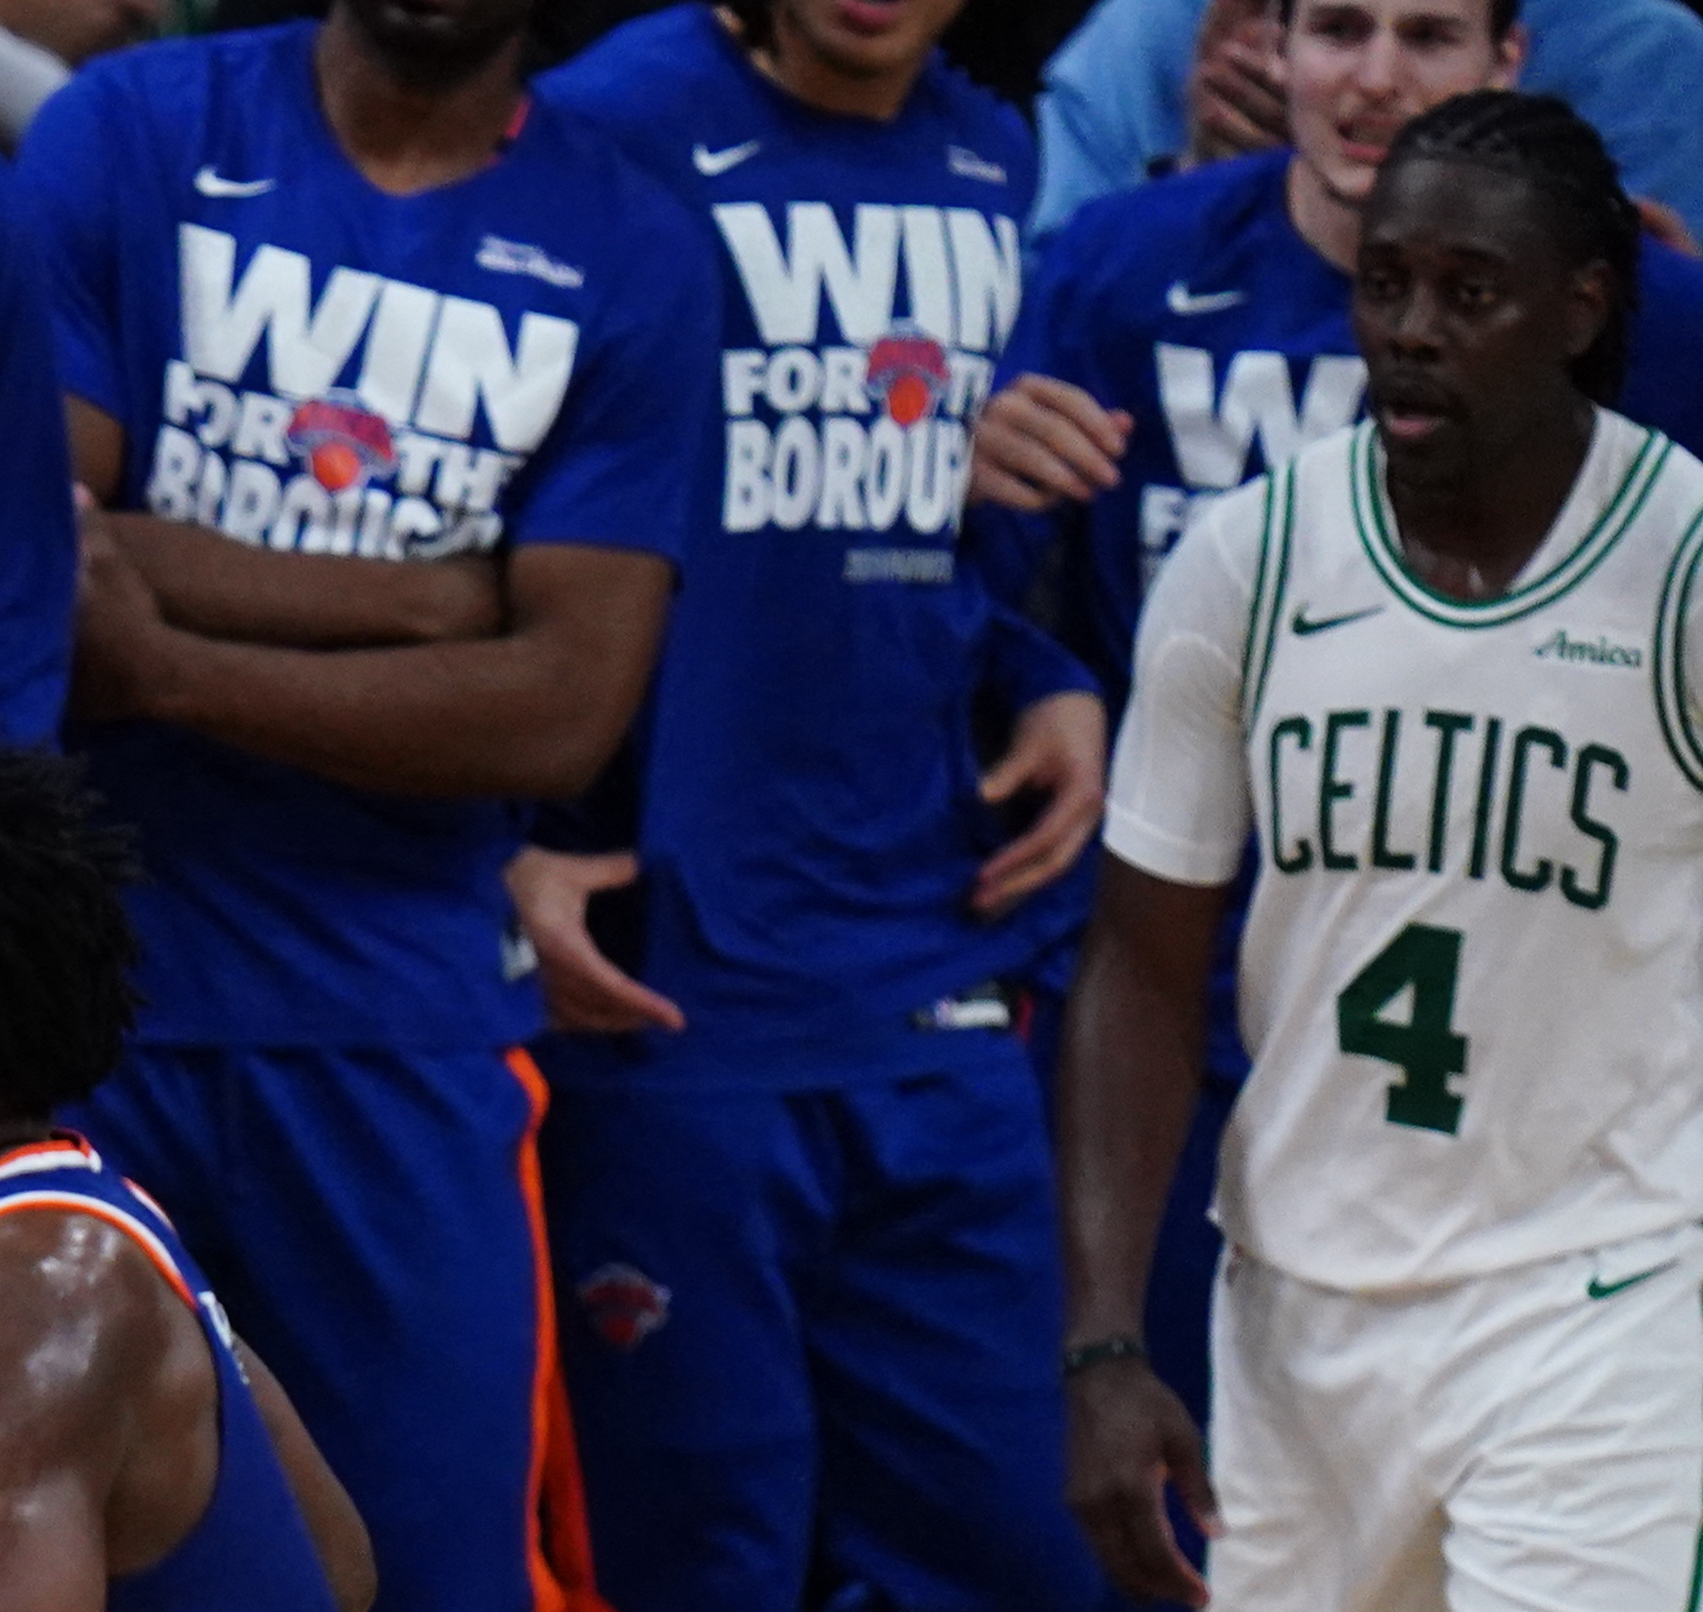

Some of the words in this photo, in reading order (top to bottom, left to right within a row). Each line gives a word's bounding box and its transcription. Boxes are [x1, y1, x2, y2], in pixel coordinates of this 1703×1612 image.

[178, 222, 580, 455] WIN
[711, 201, 1022, 358] WIN
[721, 346, 871, 416] FOR
[1270, 709, 1630, 910] CELTICS
[1337, 921, 1469, 1136] 4
